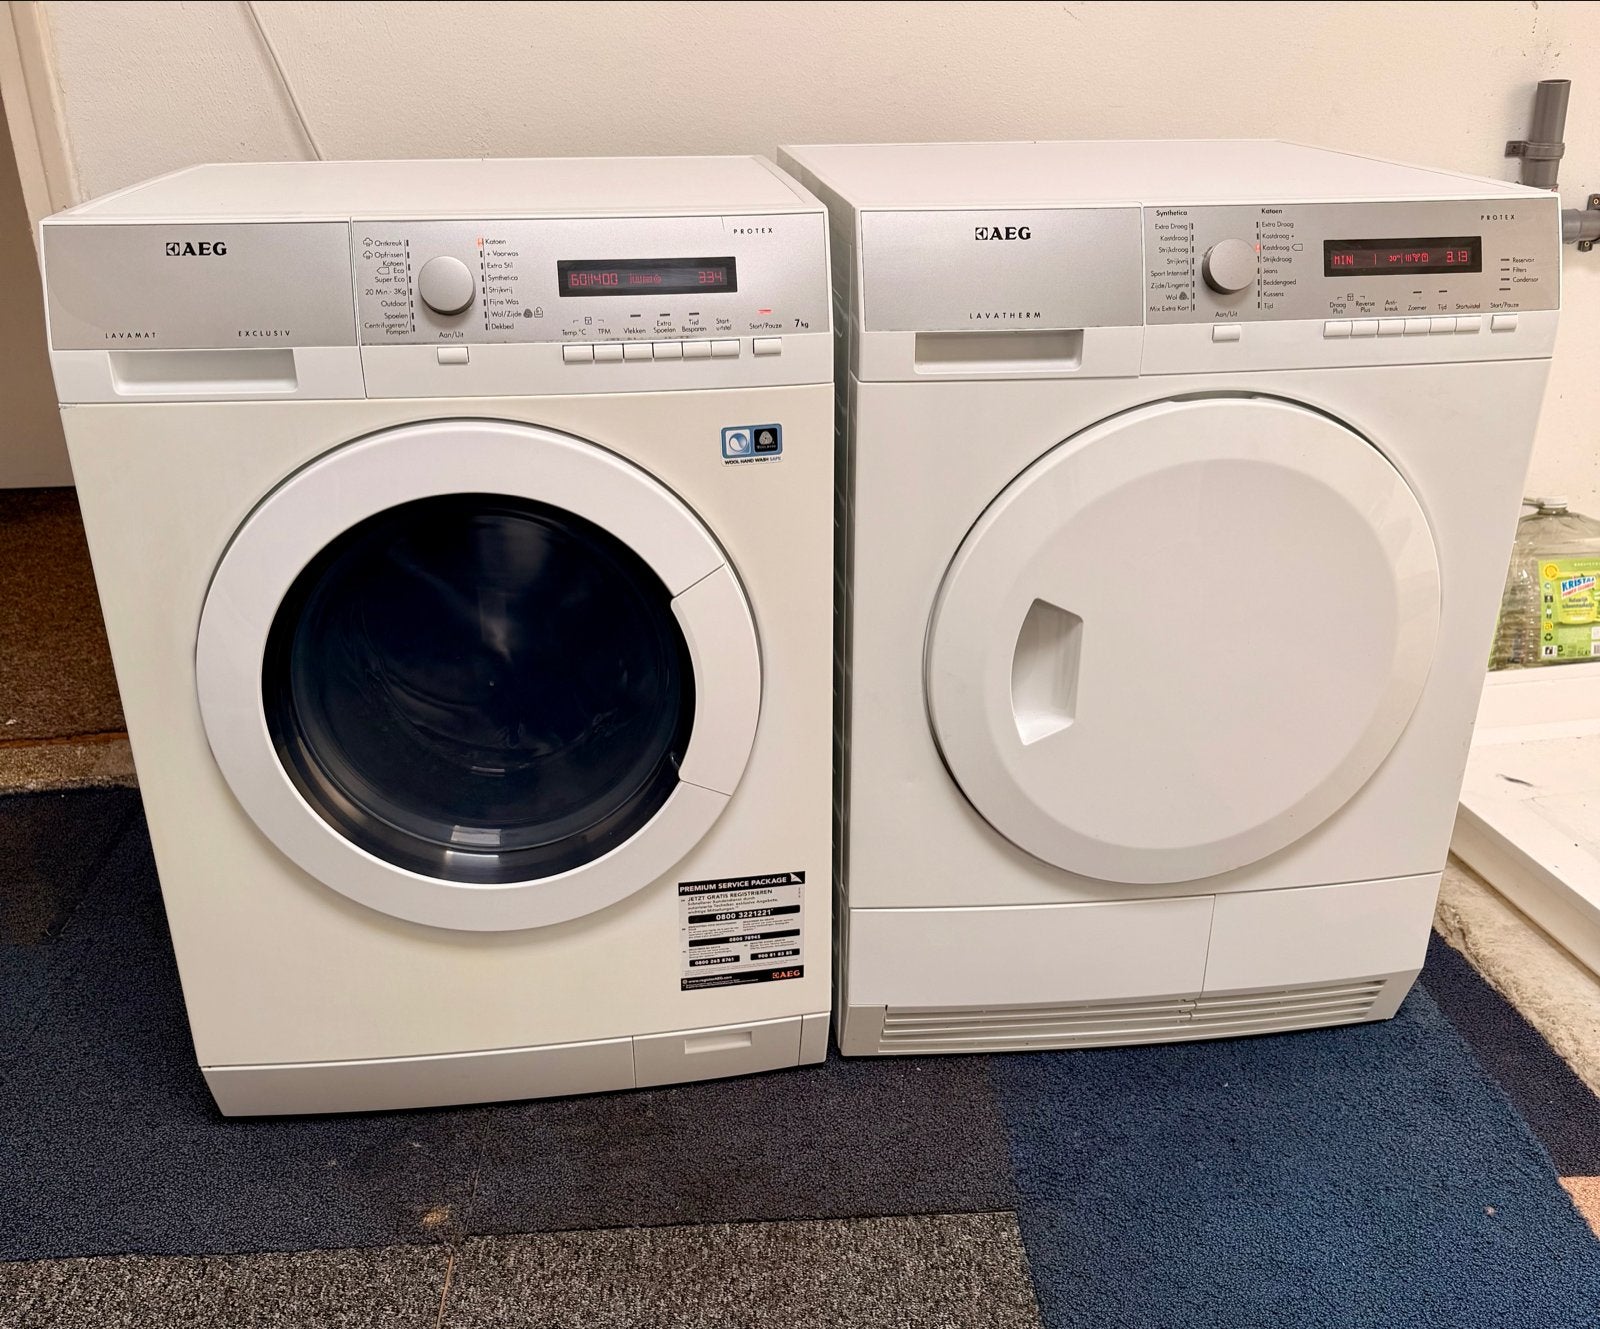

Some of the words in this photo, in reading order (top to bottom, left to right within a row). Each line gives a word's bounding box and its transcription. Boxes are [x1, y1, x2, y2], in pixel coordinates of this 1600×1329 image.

[1277, 221, 1294, 229] Droog
[989, 226, 1031, 241] AEG
[182, 242, 227, 256] AEG
[1334, 255, 1352, 265] MIN
[680, 884, 716, 893] PREMIUM
[718, 881, 749, 889] SERVICE
[751, 877, 787, 886] PACKAGE
[730, 889, 773, 898] REGISTRIEREN
[780, 970, 800, 978] AEG
